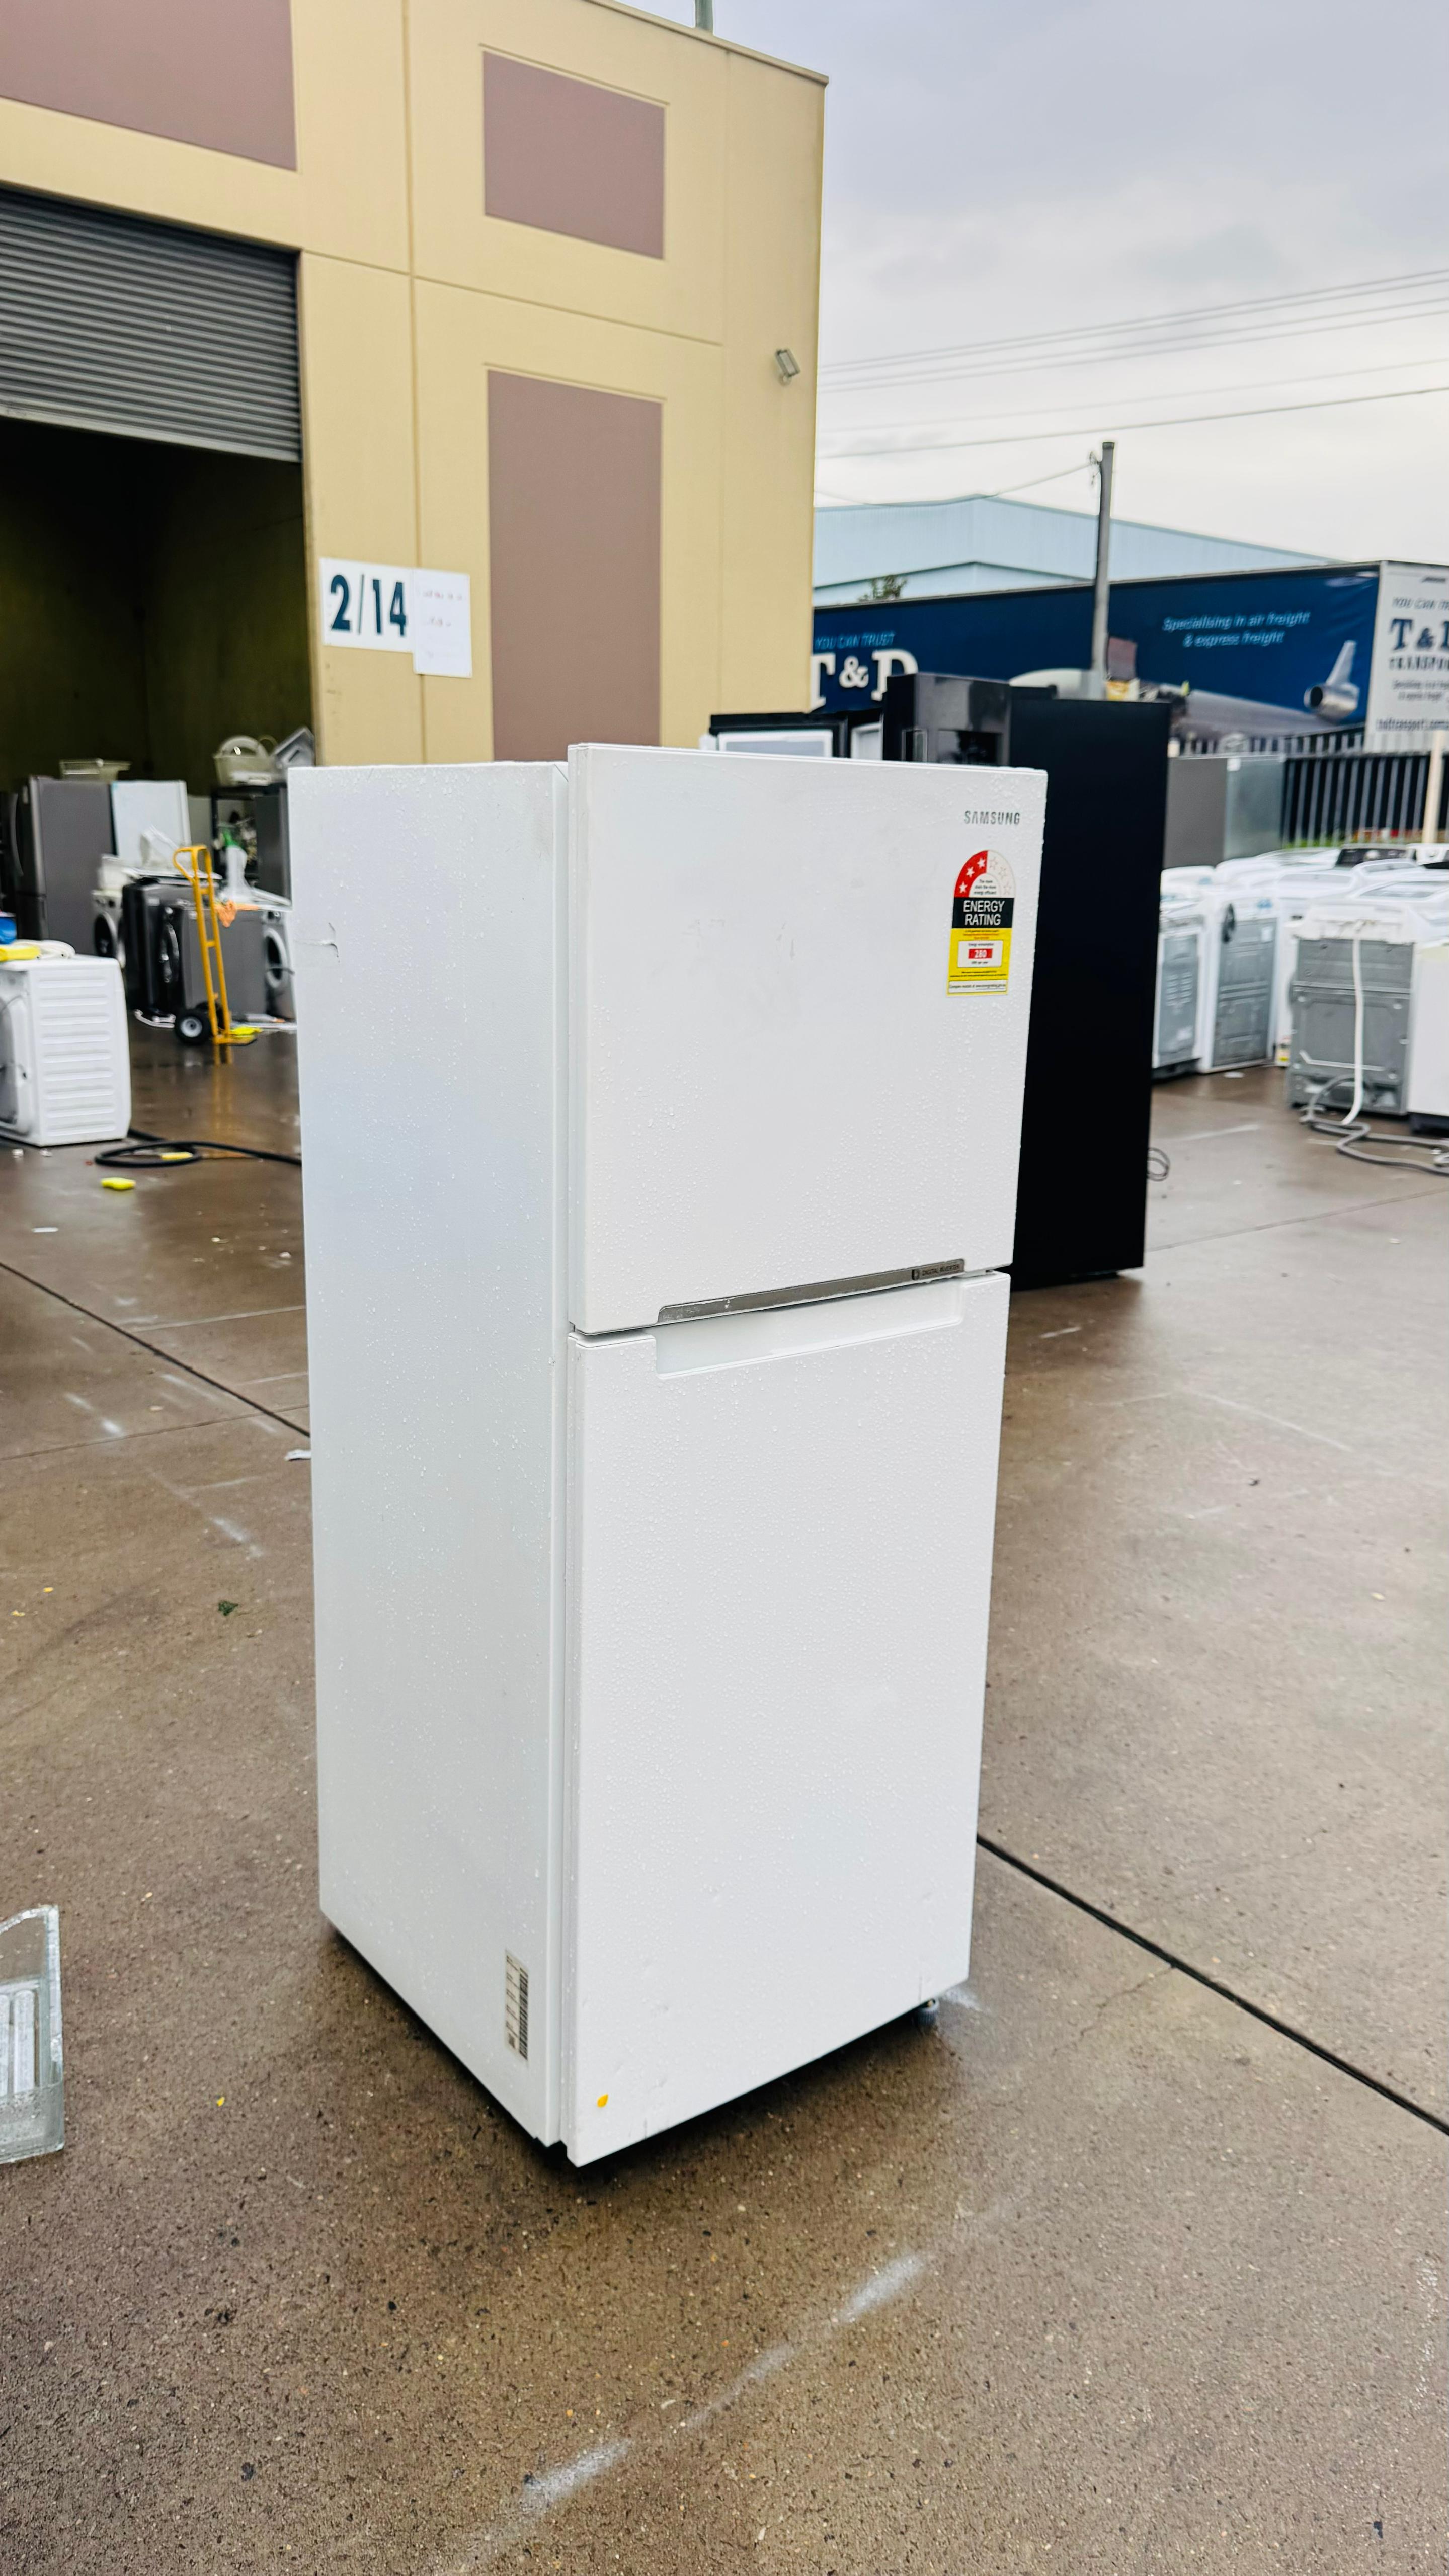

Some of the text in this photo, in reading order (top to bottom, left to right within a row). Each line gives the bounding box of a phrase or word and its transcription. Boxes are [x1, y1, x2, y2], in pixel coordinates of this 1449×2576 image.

[330, 574, 407, 637] 2/14
[816, 631, 896, 650] YOU CAN TRUST
[964, 810, 1020, 825] SAMSUNG
[963, 900, 1005, 913] ENERGY
[964, 913, 1002, 926] RATING
